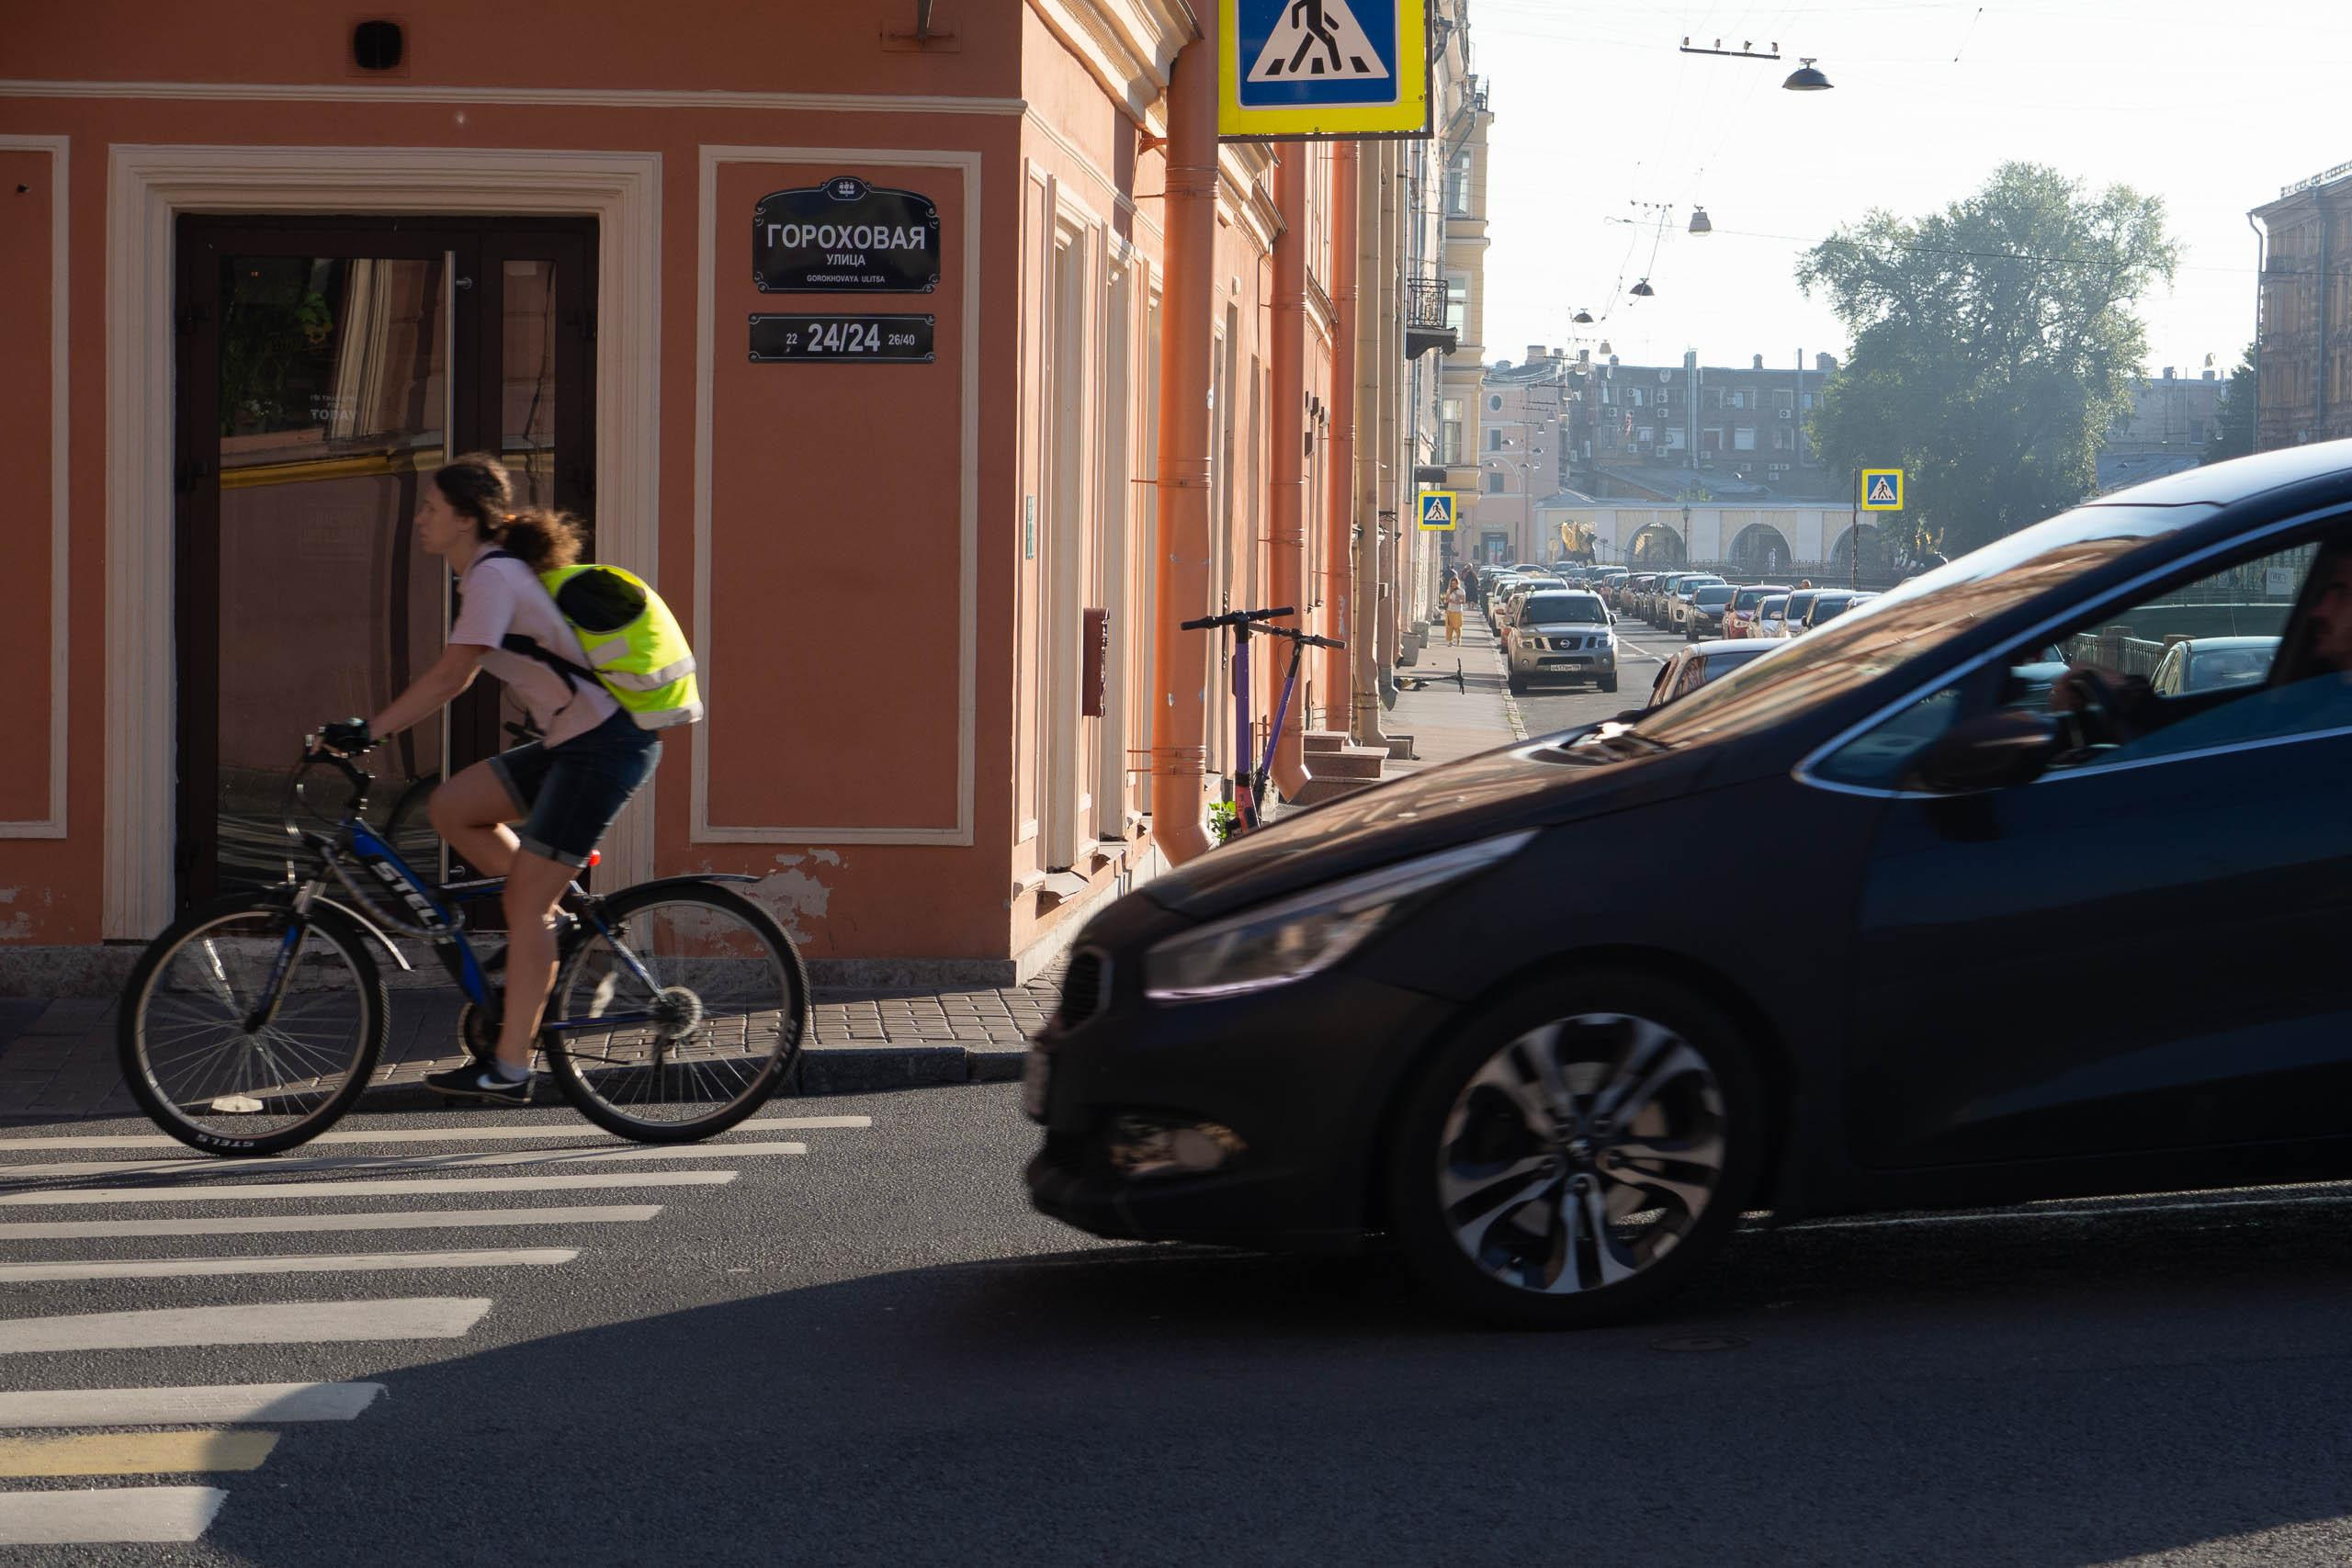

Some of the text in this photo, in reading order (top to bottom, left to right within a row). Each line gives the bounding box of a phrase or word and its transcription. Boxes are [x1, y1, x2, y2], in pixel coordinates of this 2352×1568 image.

[767, 223, 925, 250] ГОРОХОВАЯ
[826, 254, 865, 266] УЛИЦА
[807, 275, 886, 284] GOROKHOVAYA ULITSA
[786, 323, 915, 352] 22 24/24 26/40
